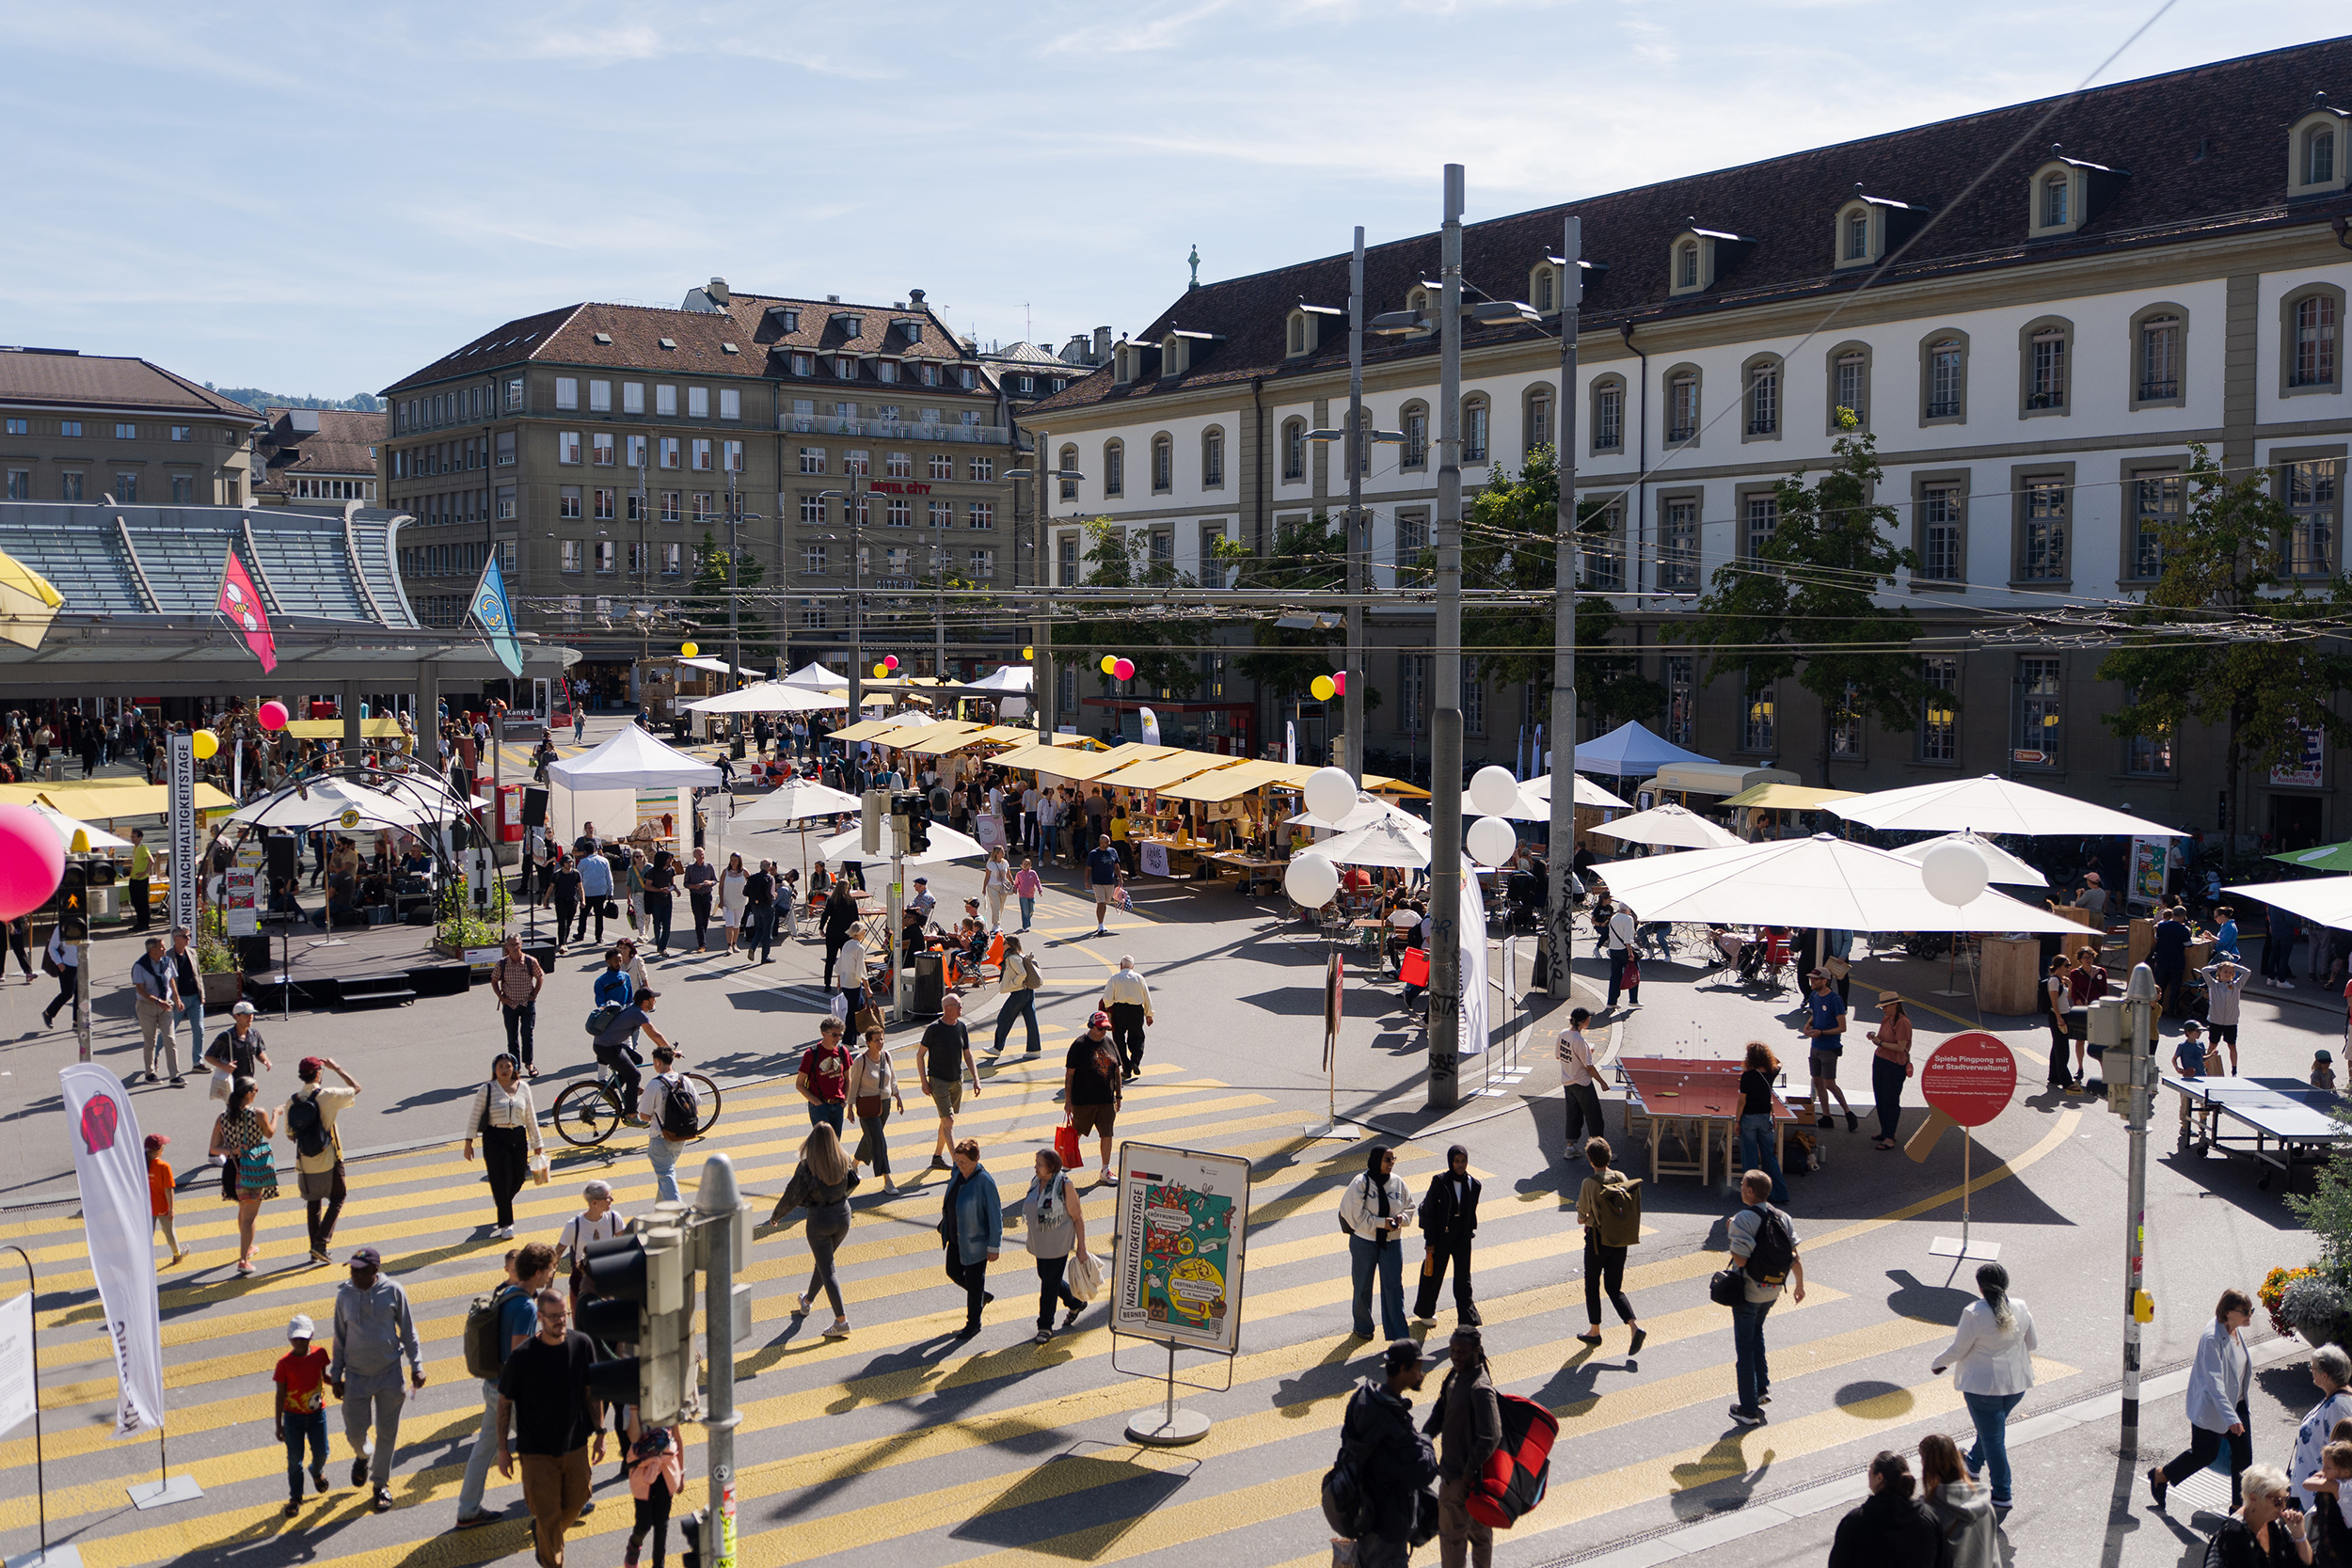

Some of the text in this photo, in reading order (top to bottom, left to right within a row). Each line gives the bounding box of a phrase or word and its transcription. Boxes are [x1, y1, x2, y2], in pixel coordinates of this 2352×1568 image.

[871, 482, 905, 493] HOTEL
[2277, 776, 2315, 785] Ausstellung
[178, 744, 191, 889] NACHHALTIGKEITSTAGE
[1946, 1063, 2010, 1072] Stadtverwaltung!
[1147, 1212, 1190, 1222] ERÖFFNUNGSFEST
[1126, 1189, 1143, 1307] NACHHALTIGKEITSTAGE
[1174, 1281, 1220, 1293] FESTIVALPROGRAMM
